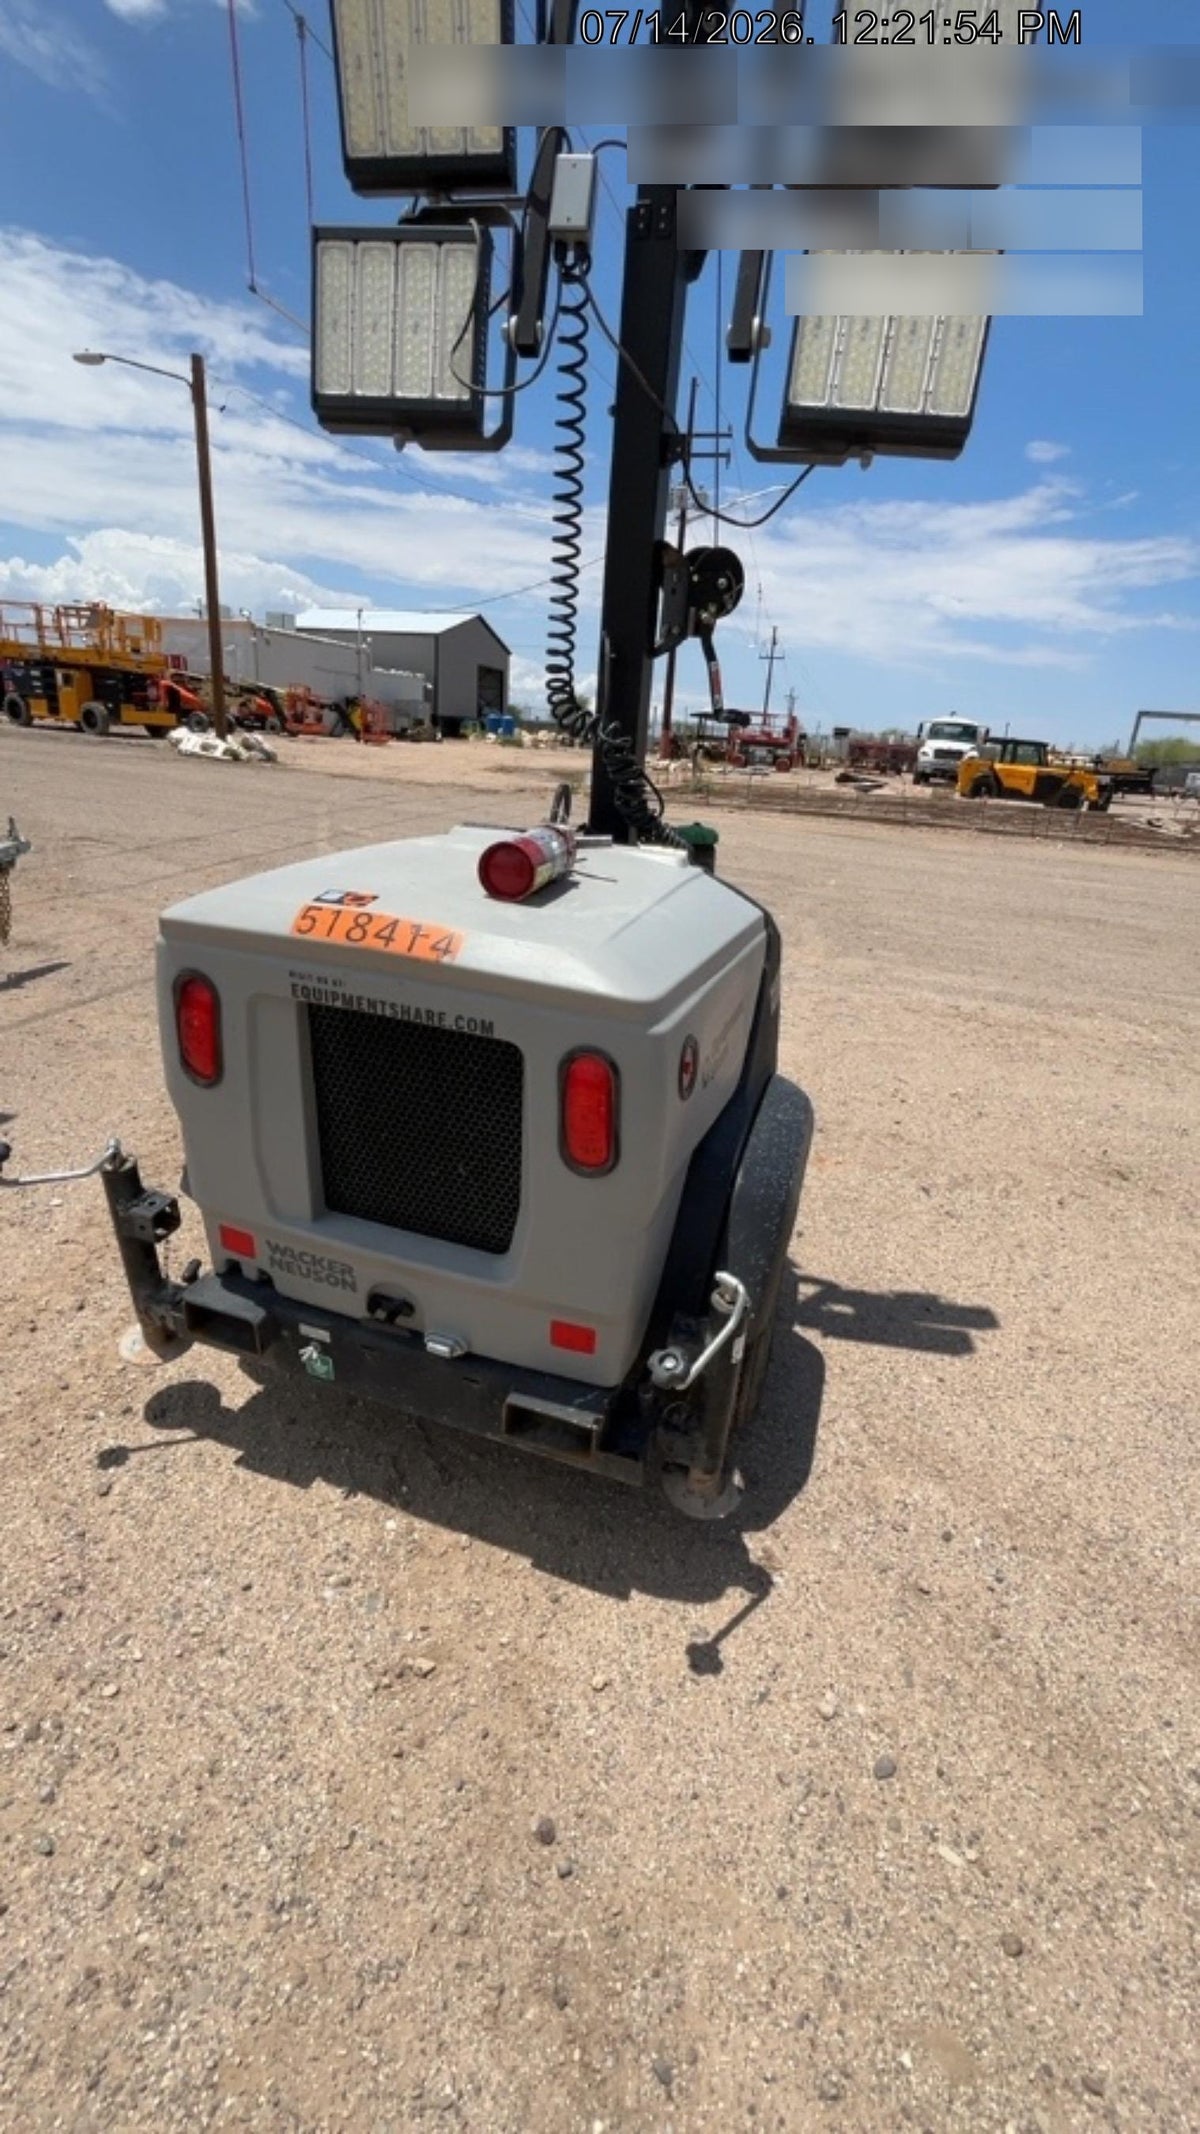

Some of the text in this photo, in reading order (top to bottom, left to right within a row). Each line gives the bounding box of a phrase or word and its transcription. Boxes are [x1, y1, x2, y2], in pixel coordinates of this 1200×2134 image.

[291, 984, 495, 1036] EQUIPMENTSHARE.COM
[266, 1240, 355, 1276] WACKER
[270, 1256, 357, 1292] NEUSON
